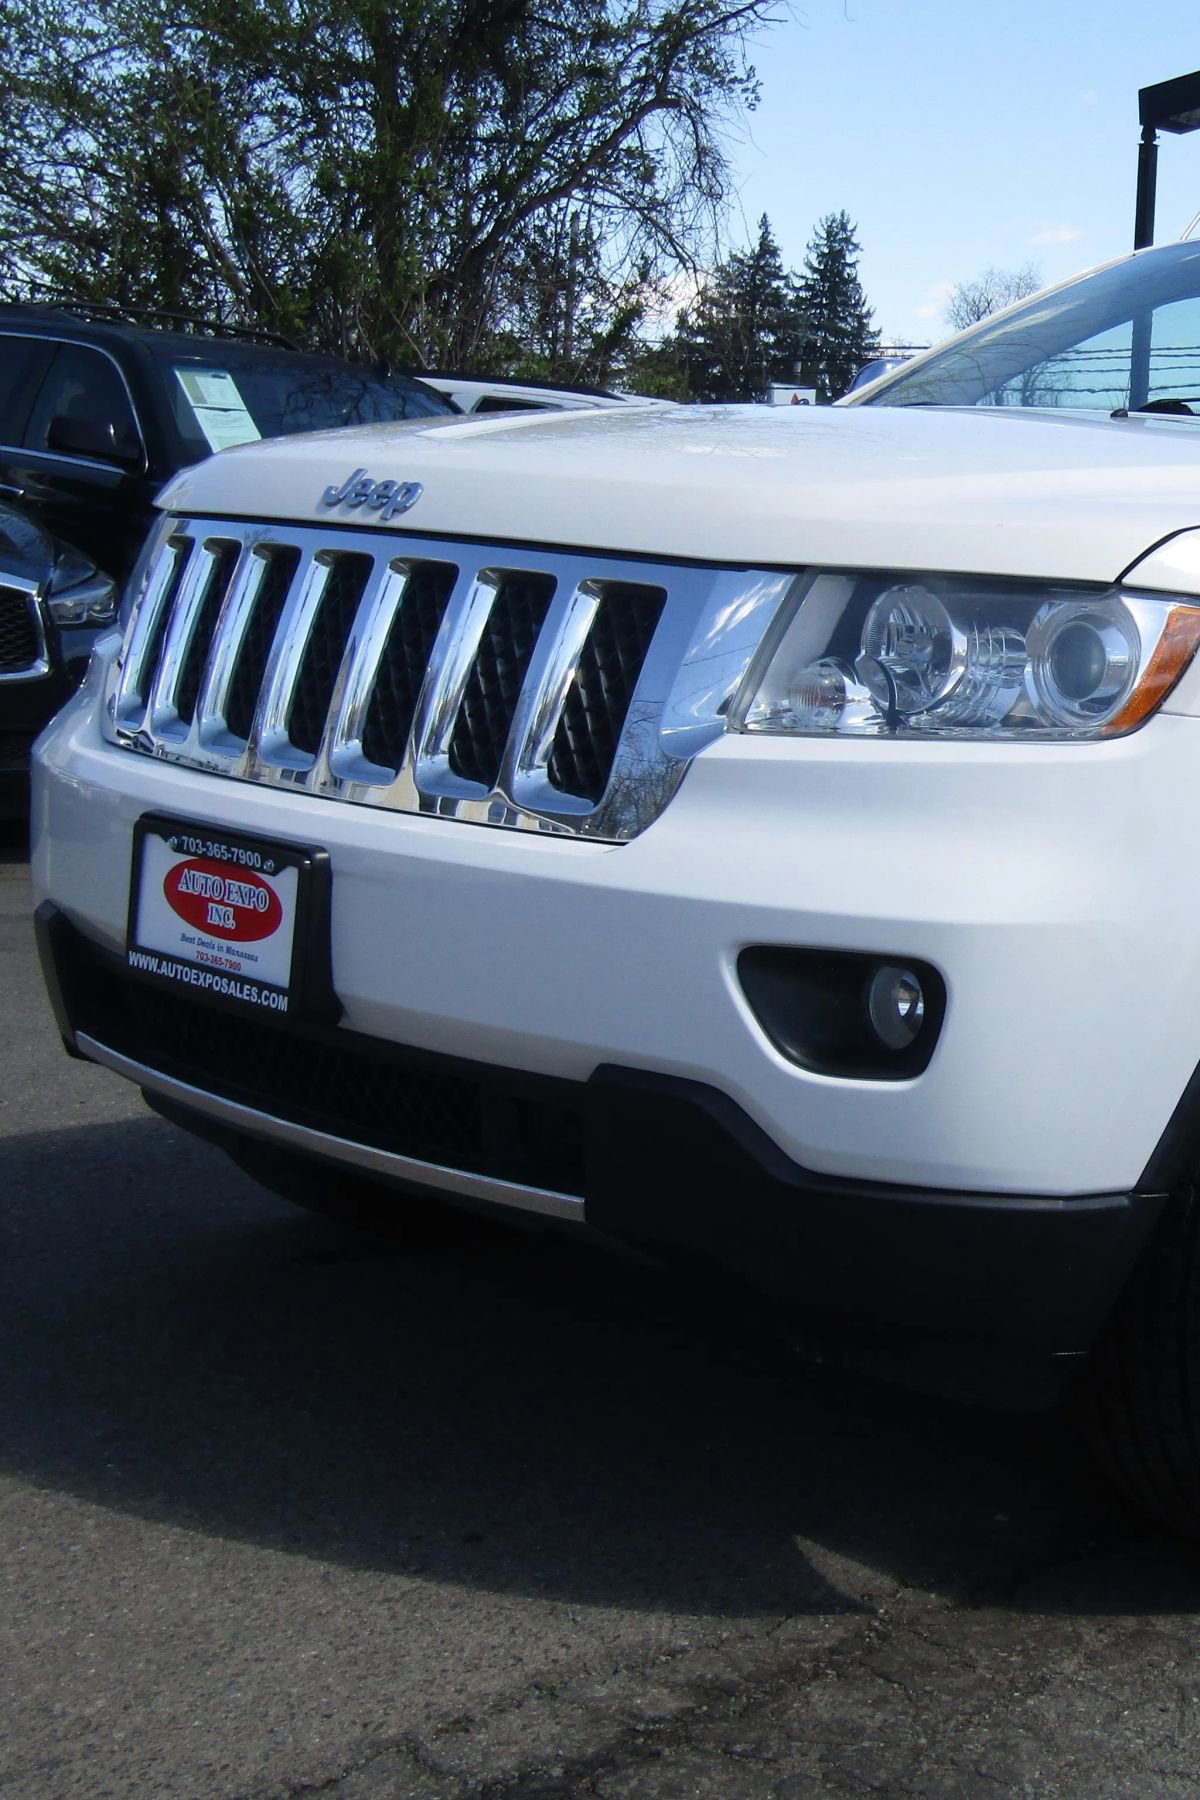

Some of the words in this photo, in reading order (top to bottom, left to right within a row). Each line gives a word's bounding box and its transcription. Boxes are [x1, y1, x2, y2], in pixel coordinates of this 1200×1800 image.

[321, 468, 424, 520] Jeep
[181, 836, 262, 868] 703-365-7900
[178, 868, 224, 900] AUTO
[224, 879, 270, 912] EXPO
[207, 902, 236, 930] INC.
[180, 933, 196, 946] Best
[196, 937, 216, 950] Deals
[217, 944, 224, 952] in
[225, 945, 259, 962] Manassas
[195, 951, 242, 971] 703-365-7900
[128, 950, 289, 1012] WWW.AUTOEXPOSALES.COM
